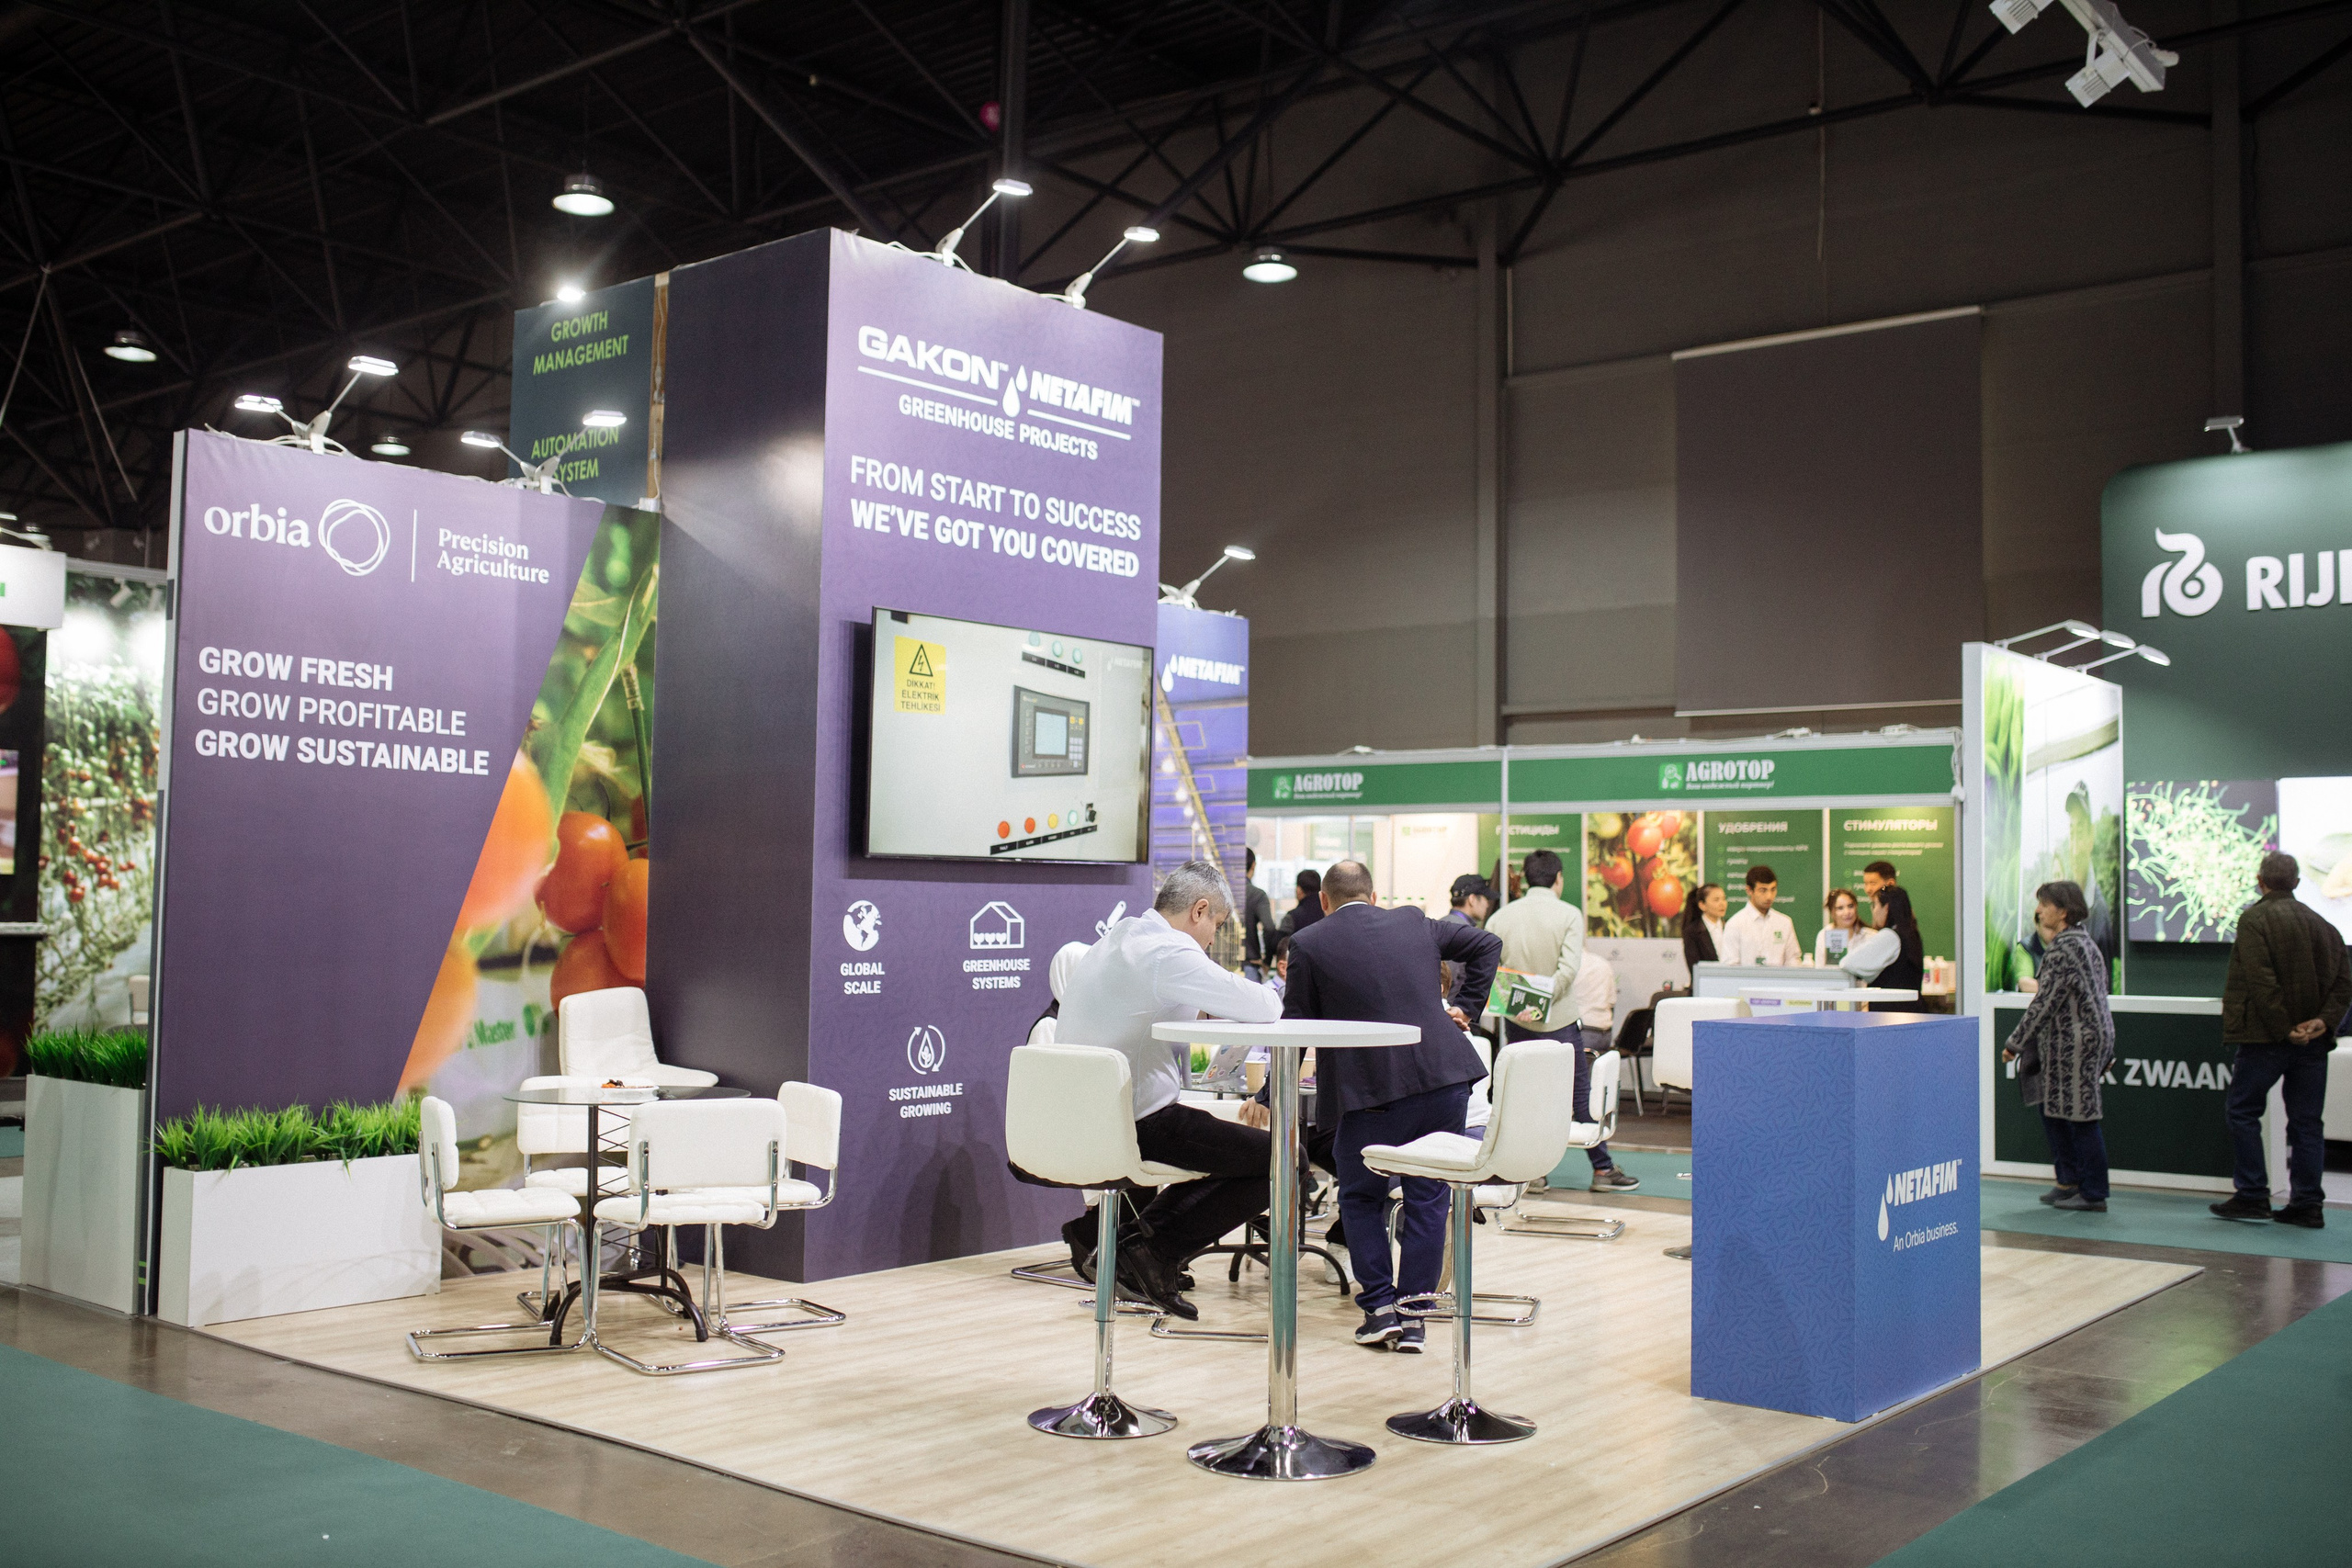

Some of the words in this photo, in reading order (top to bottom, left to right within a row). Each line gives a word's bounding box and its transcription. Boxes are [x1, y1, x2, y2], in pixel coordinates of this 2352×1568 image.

[551, 310, 608, 343] GROWTH
[533, 334, 629, 376] MANAGEMENT
[531, 426, 619, 459] AUTOMATION
[899, 394, 1015, 441] GREENHOUSE
[1019, 423, 1099, 461] PROJECTS
[851, 455, 924, 497] FROM
[930, 472, 1006, 513] START
[1009, 489, 1040, 521] TO
[1045, 497, 1142, 541] SUCCESS
[204, 503, 311, 548] orbia
[850, 498, 930, 540] WE'VE
[934, 515, 985, 550] GOT
[989, 525, 1036, 559] YOU
[1041, 536, 1140, 578] COVERED
[438, 527, 529, 560] Precision
[436, 549, 549, 584] Agriculture
[198, 647, 293, 682] GROW
[300, 657, 393, 691] FRESH
[197, 687, 290, 721] GROW
[299, 696, 466, 737] PROFITABLE
[195, 728, 288, 761] GROW
[297, 737, 490, 776] SUSTAINABLE
[1294, 772, 1363, 792] AGROTOP
[1686, 759, 1775, 782] AGROTOP
[1718, 821, 1788, 835] УДОБРЕНИЯ
[1843, 818, 1938, 831] СТИМУЛЯТОРЫ
[840, 963, 885, 976] GLOBAL
[963, 958, 1030, 974] GREENHOUSE
[972, 976, 1021, 989] SYSTEMS
[844, 981, 881, 995] SCALE
[2124, 1057, 2234, 1090] ZWAAN
[888, 1083, 963, 1101] SUSTAINABLE
[899, 1102, 952, 1118] GROWING
[1893, 1235, 1904, 1252] An
[1905, 1229, 1925, 1248] Orbia
[1926, 1222, 1959, 1242] business.
